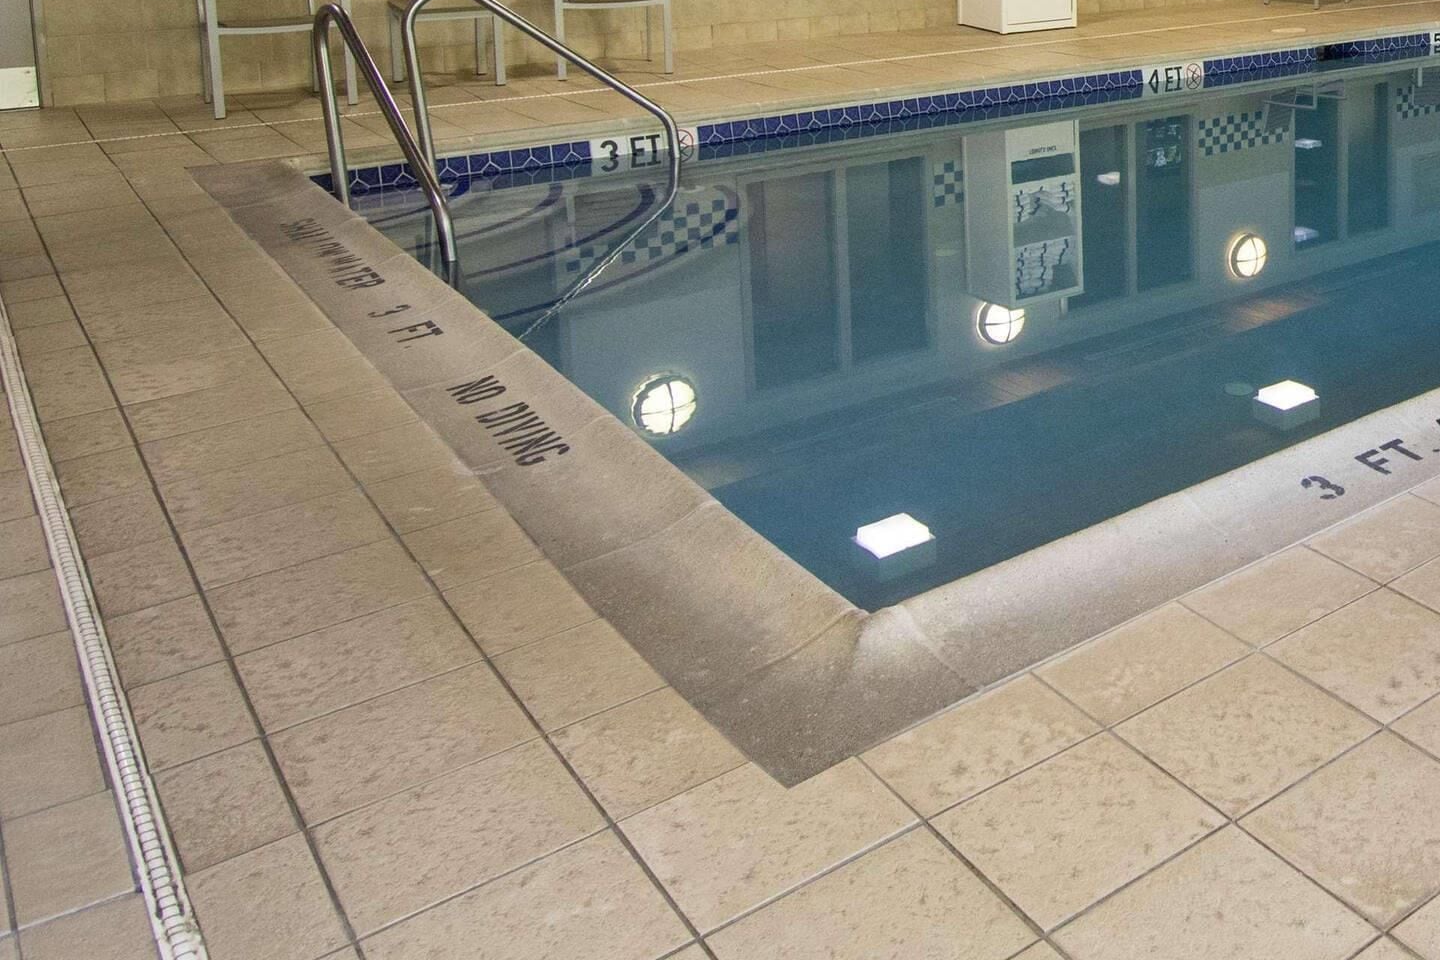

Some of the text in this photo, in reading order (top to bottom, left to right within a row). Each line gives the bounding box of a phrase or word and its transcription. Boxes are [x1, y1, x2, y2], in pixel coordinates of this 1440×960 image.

[600, 134, 660, 160] 3 FT
[368, 304, 411, 318] 3
[445, 375, 570, 466] NO DIVING
[1301, 475, 1345, 500] 3
